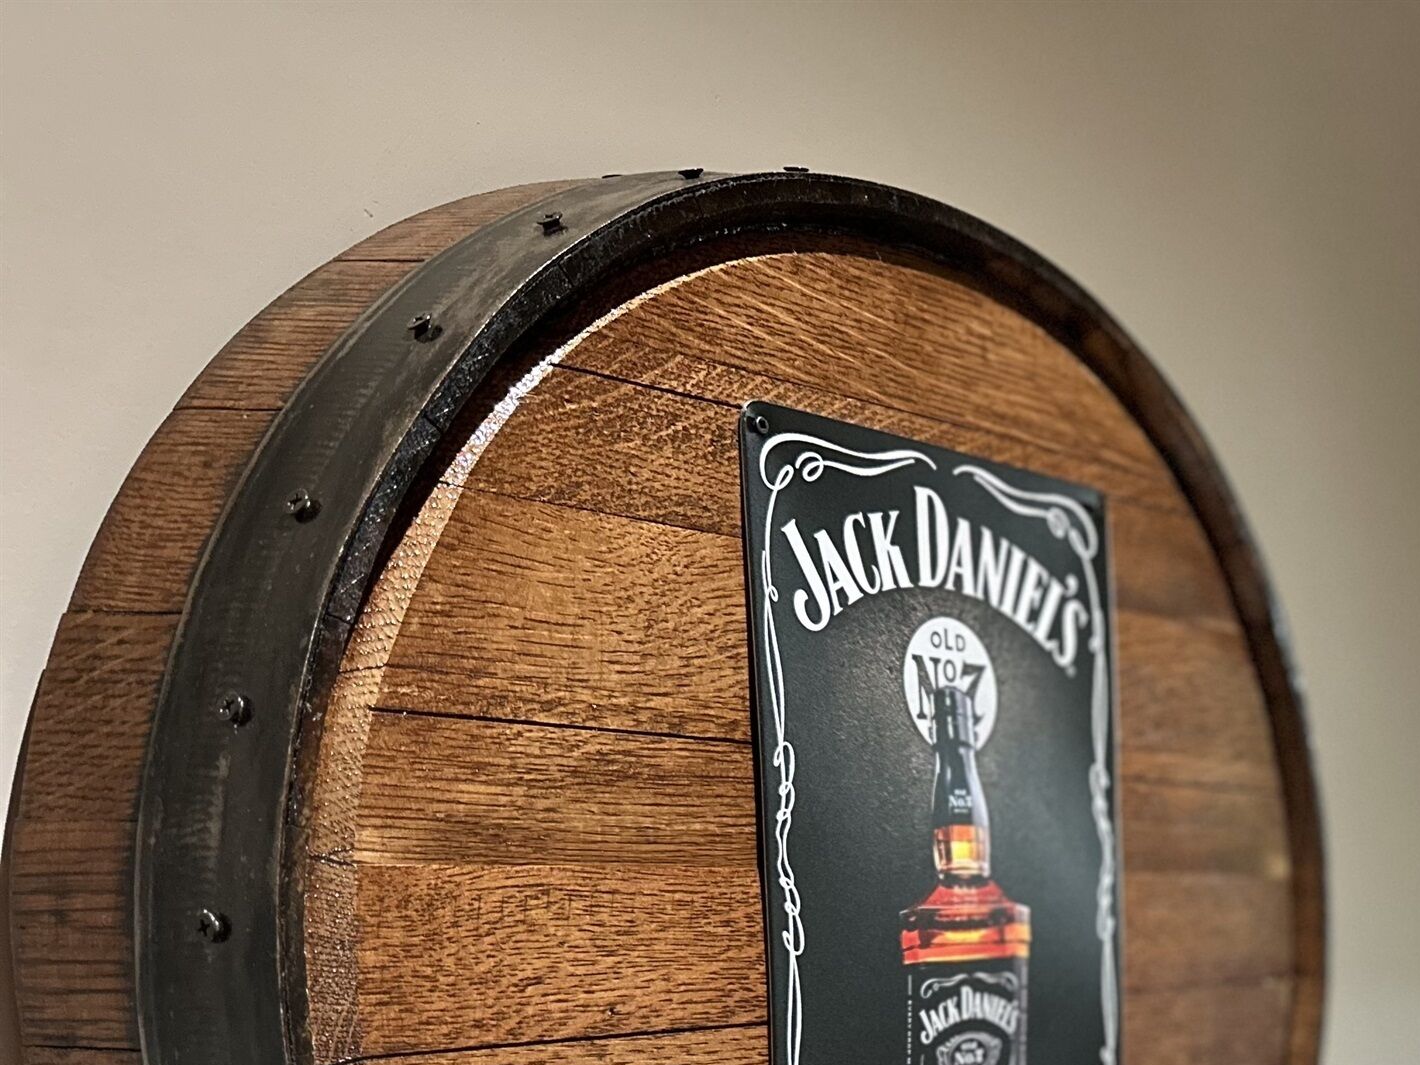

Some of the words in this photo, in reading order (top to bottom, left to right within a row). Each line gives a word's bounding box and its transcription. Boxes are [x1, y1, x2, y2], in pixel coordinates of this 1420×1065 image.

[781, 511, 914, 631] JACK
[914, 486, 1089, 667] DANIEL'S
[930, 628, 966, 652] OLD
[918, 996, 961, 1045] JACK
